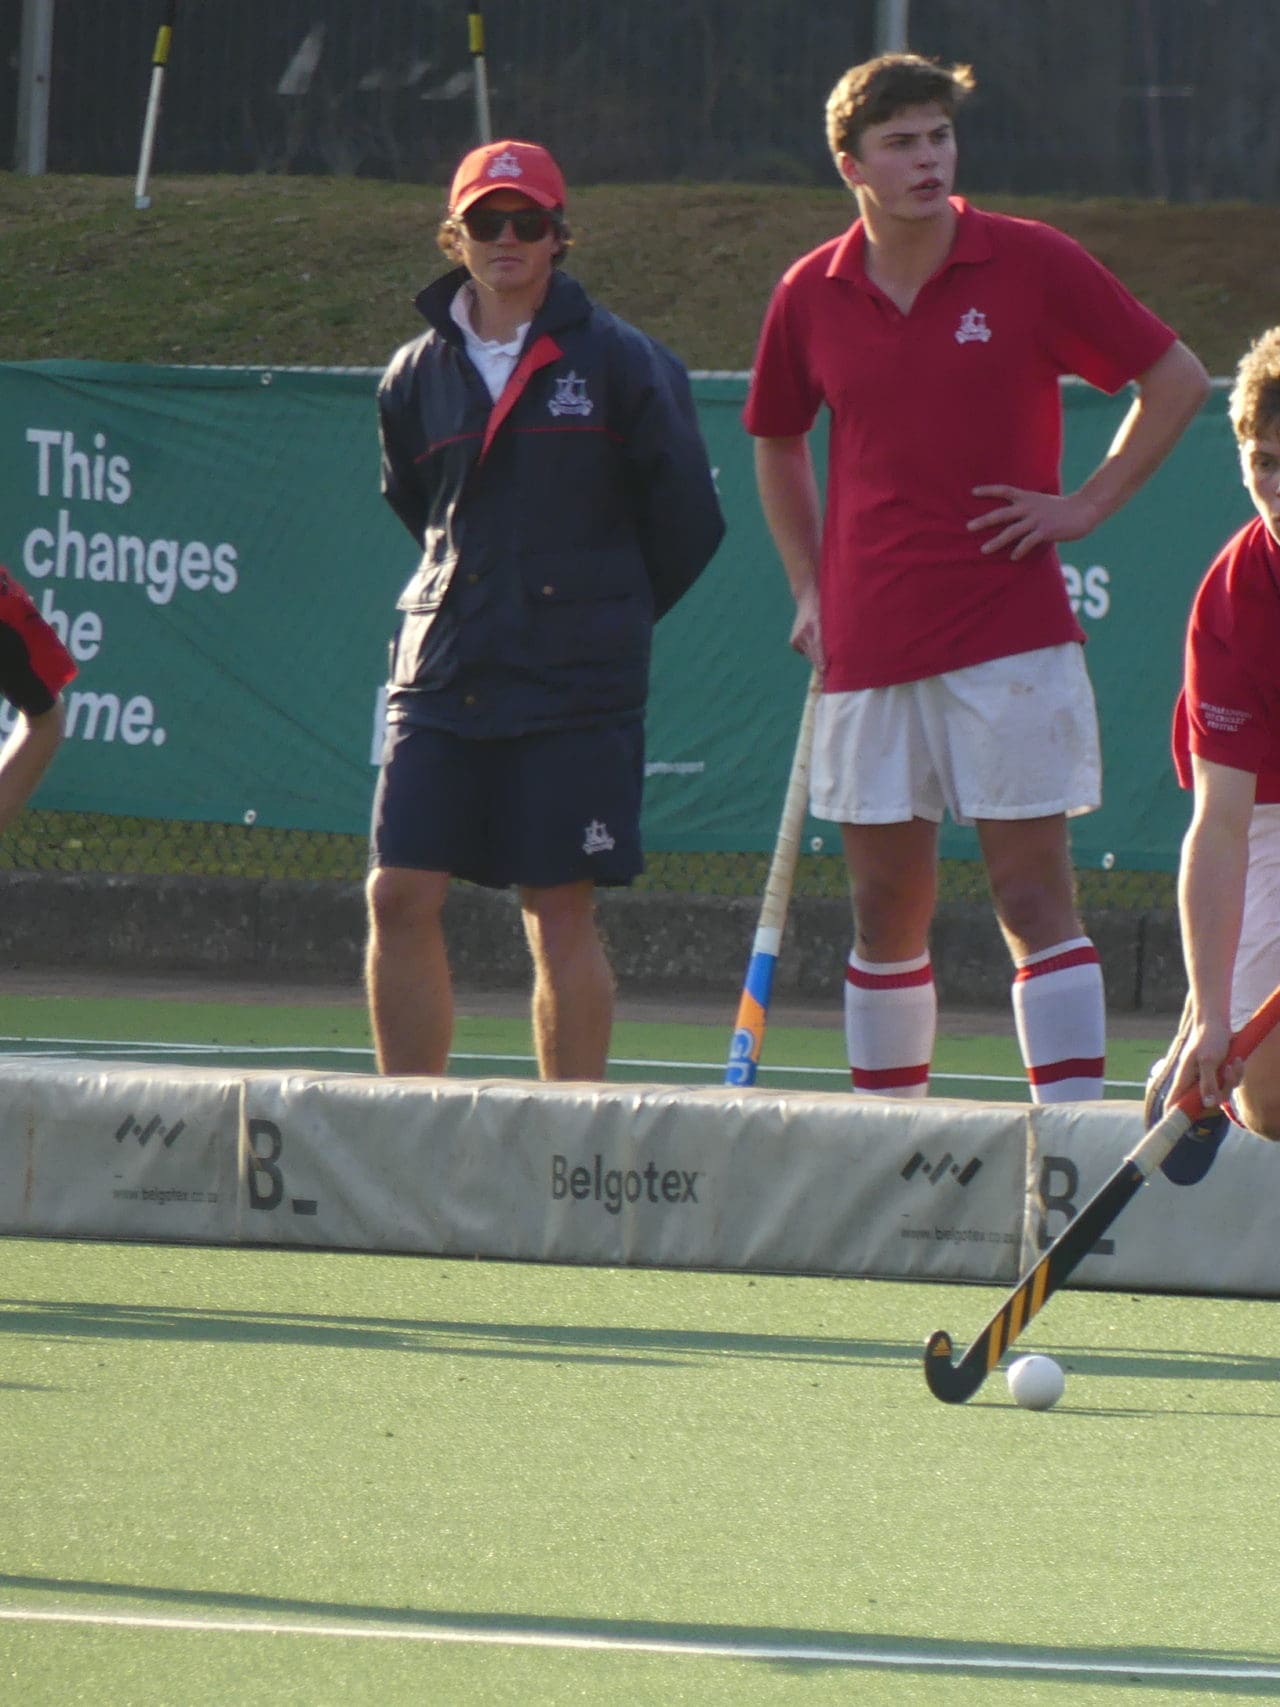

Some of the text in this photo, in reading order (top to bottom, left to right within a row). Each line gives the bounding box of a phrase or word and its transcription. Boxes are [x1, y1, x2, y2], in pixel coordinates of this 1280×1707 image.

[26, 428, 131, 504] This
[23, 508, 238, 605] changes
[29, 588, 103, 662] he
[551, 1154, 699, 1215] Belgotex
